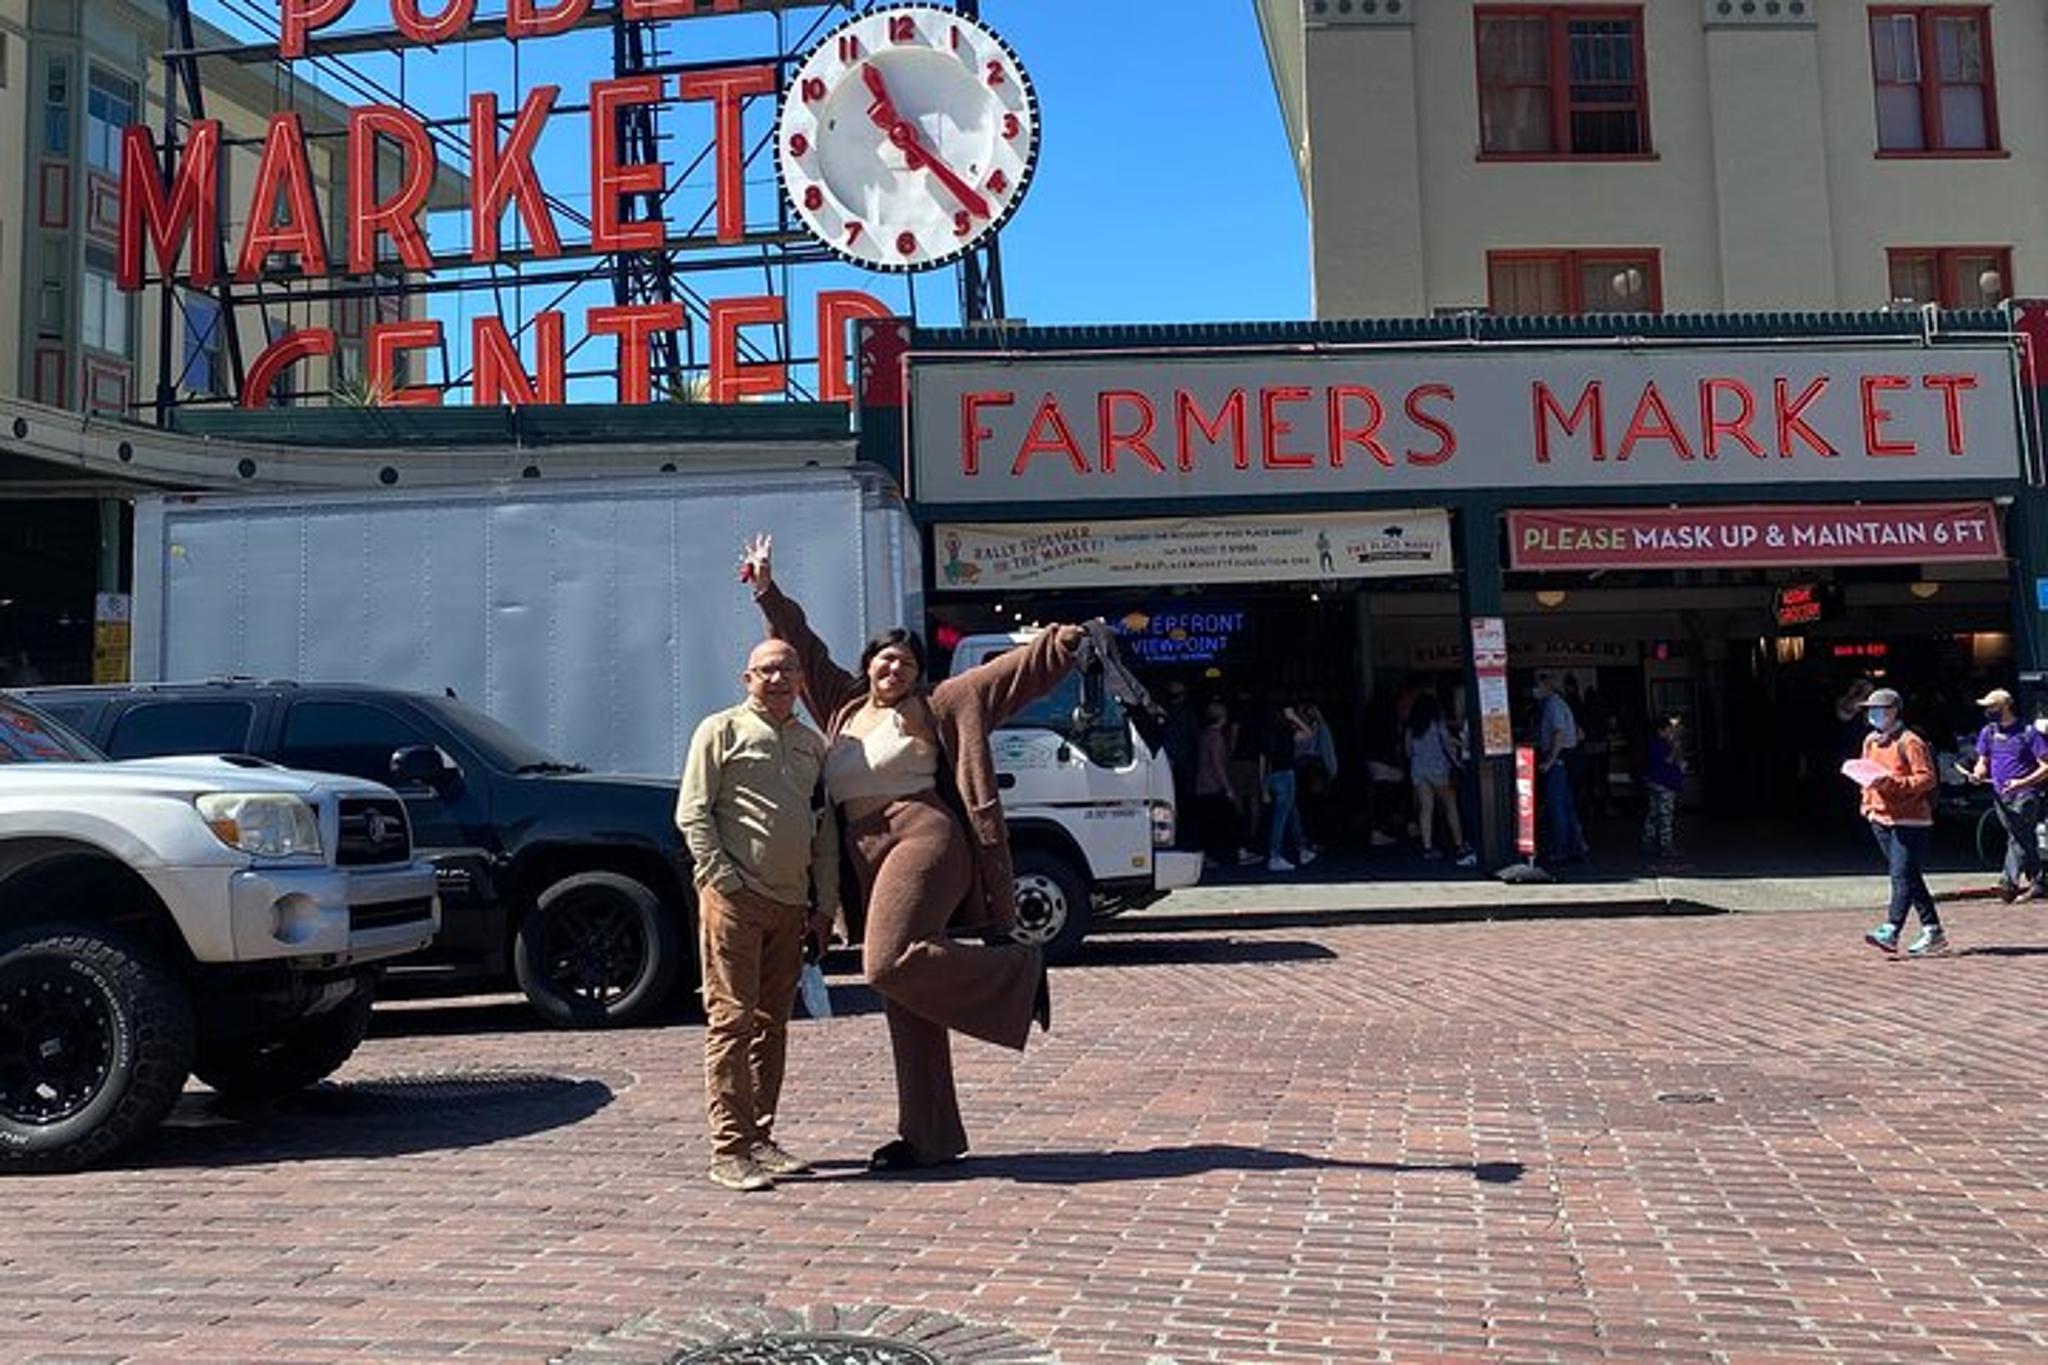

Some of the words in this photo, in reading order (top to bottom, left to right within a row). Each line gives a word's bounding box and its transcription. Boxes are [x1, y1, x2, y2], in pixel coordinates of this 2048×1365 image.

[888, 15, 915, 42] 12
[950, 25, 959, 50] 1
[839, 36, 858, 61] 11
[987, 60, 1005, 86] 2
[801, 78, 826, 104] 10
[1002, 113, 1020, 139] 3
[790, 133, 808, 157] 9
[117, 66, 777, 291] MARKET
[986, 169, 1007, 194] 4
[804, 185, 823, 210] 8
[844, 221, 863, 247] 7
[953, 210, 971, 237] 5
[896, 231, 916, 255] 6
[961, 384, 1456, 475] FARMERS
[1533, 375, 1979, 467] MARKET
[1524, 526, 1627, 551] PLEASE
[1633, 525, 1714, 549] MASK
[1720, 525, 1757, 548] UP
[1765, 525, 1788, 547] &
[1792, 522, 1928, 547] MAINTAIN
[1933, 522, 1949, 544] 6
[1955, 519, 1987, 542] FT
